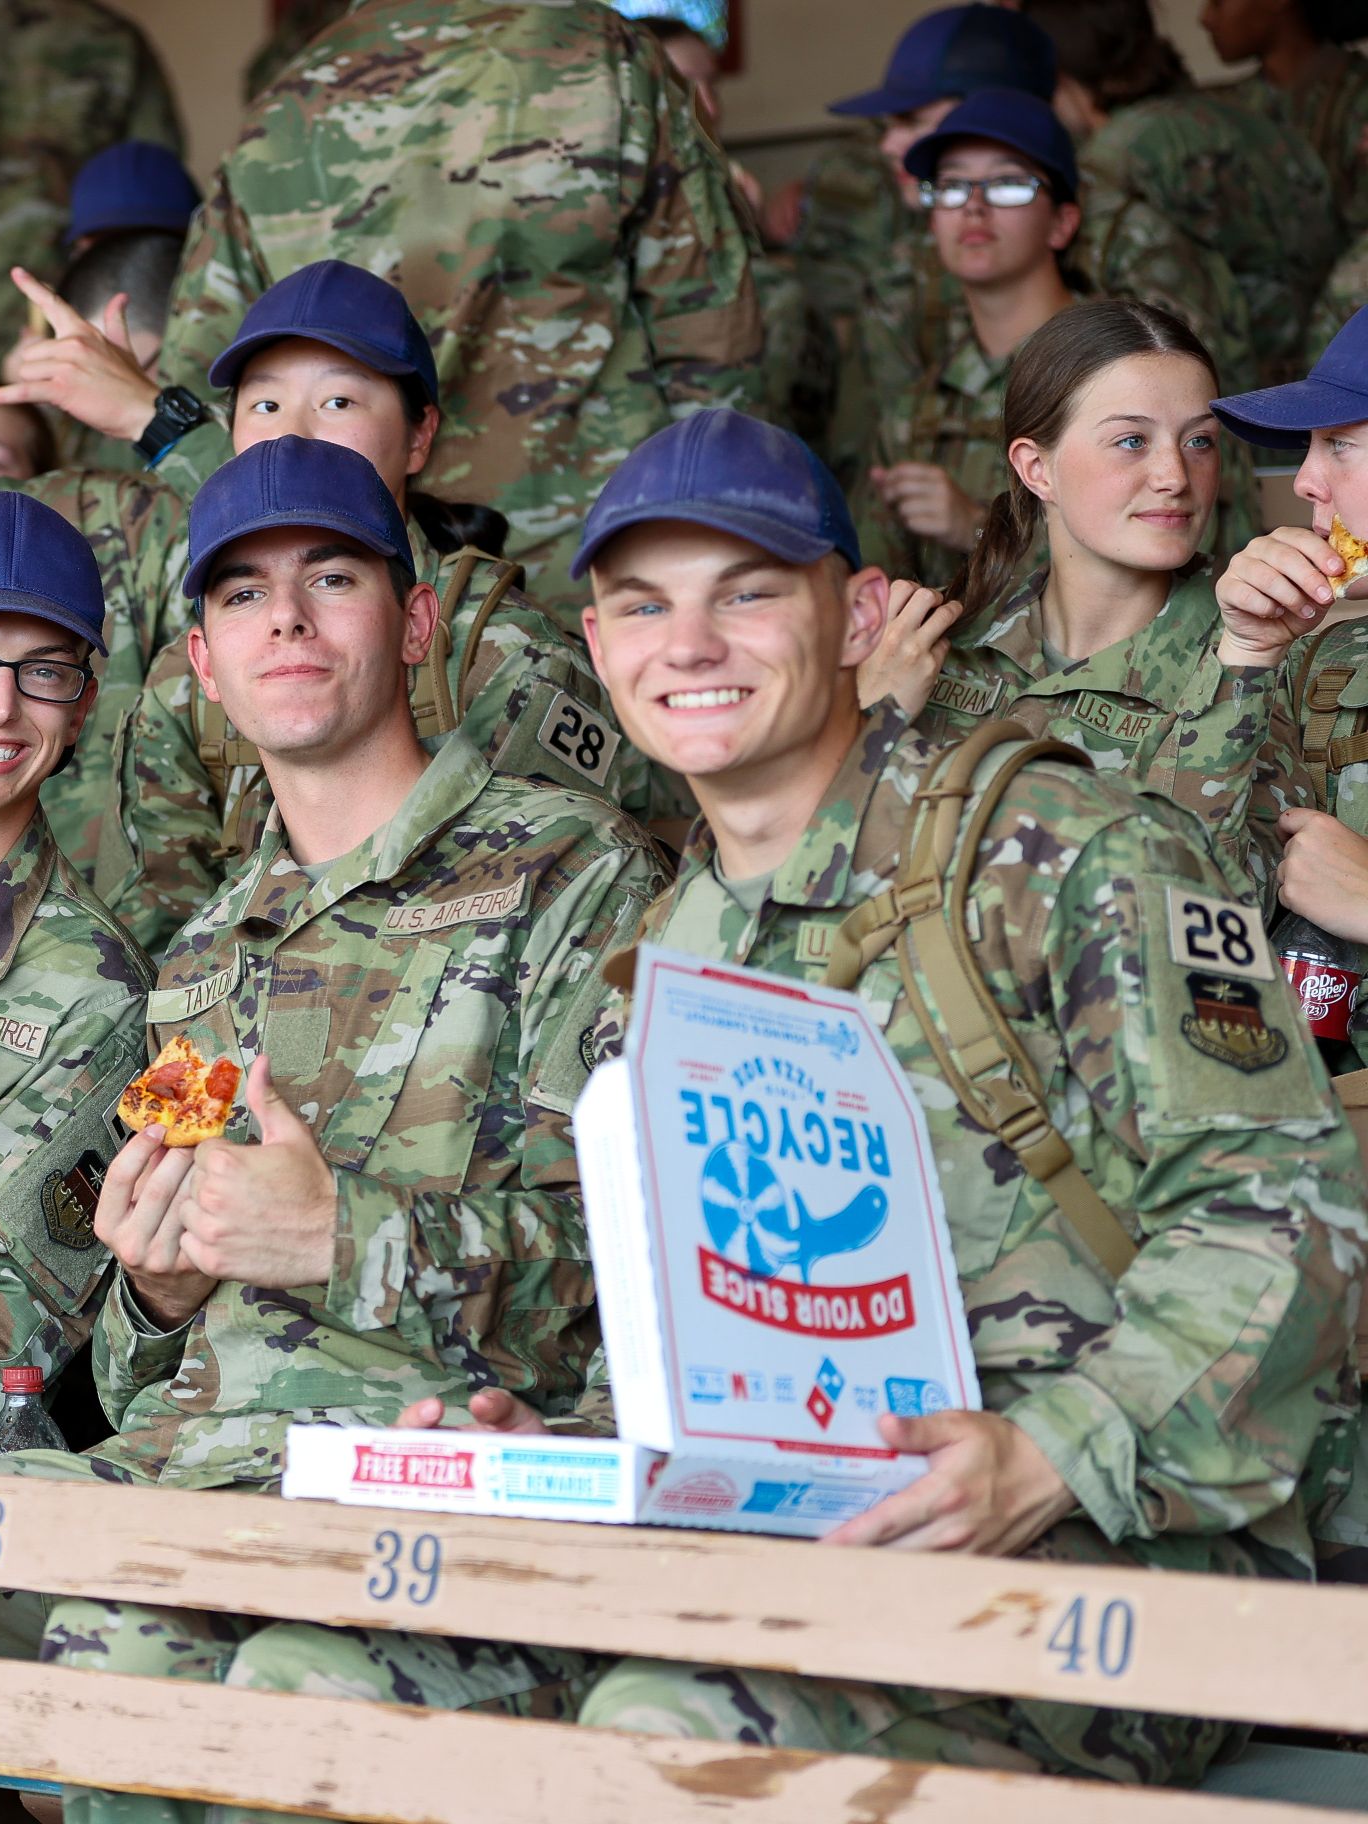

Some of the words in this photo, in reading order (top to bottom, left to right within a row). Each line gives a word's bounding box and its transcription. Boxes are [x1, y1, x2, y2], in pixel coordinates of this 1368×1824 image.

[549, 705, 606, 771] 28
[1076, 692, 1112, 731] U.S.
[1115, 714, 1153, 738] AIR
[386, 908, 426, 930] U.S.
[430, 899, 466, 926] AIR
[467, 880, 522, 916] FORCE
[1183, 901, 1255, 967] 28
[185, 967, 234, 1014] TAYLOR
[1304, 975, 1345, 1001] Pepper
[1319, 974, 1336, 988] Dr
[1308, 1005, 1320, 1016] 23
[680, 1089, 892, 1178] RECYCLE
[707, 1261, 788, 1322] SLICE
[795, 1291, 866, 1331] YOUR
[870, 1286, 907, 1326] DO
[359, 1451, 405, 1483] FREE
[368, 1530, 441, 1606] 39
[1047, 1596, 1135, 1678] 40
